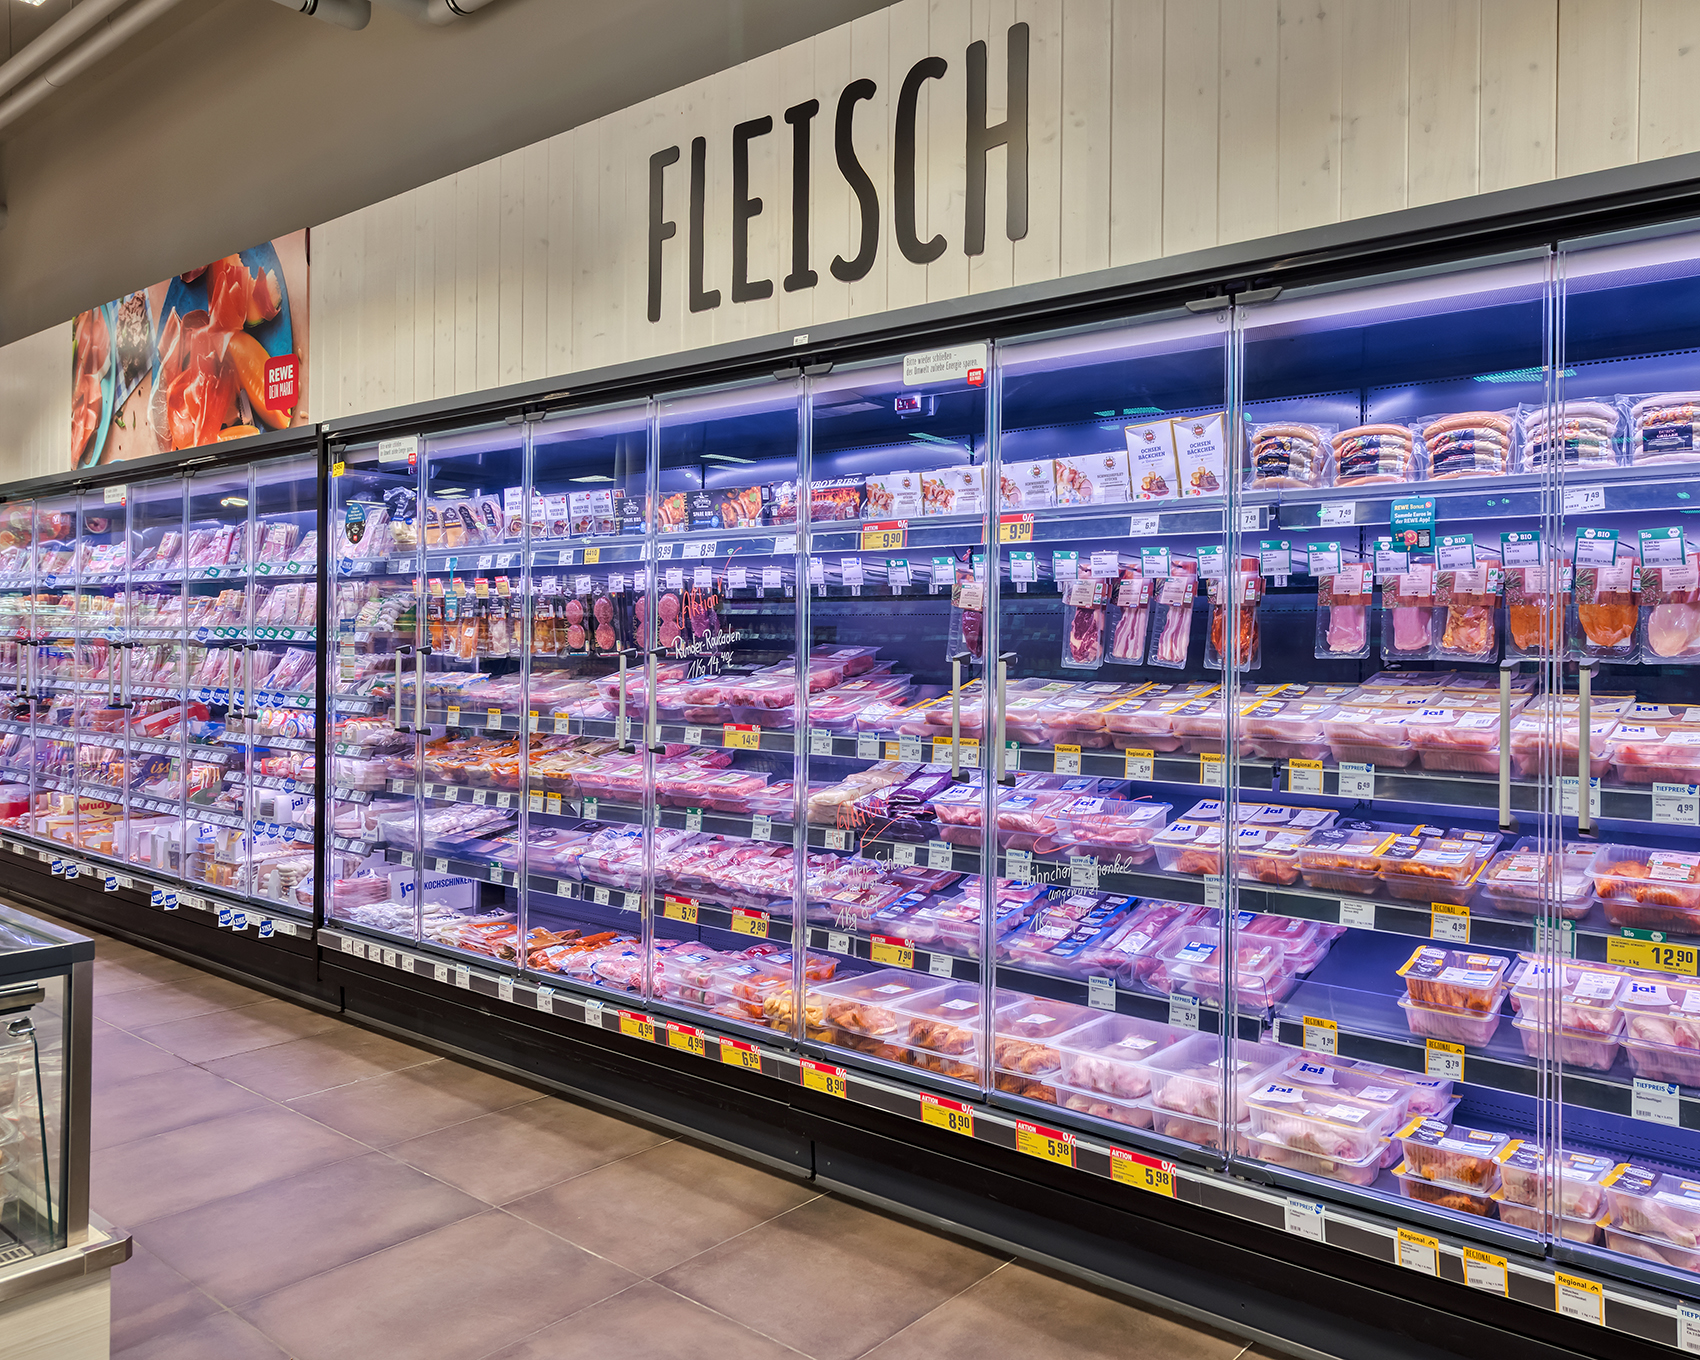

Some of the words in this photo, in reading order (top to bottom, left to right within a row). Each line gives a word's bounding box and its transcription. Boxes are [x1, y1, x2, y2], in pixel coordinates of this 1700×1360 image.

[648, 22, 1029, 322] FLEISCH
[269, 364, 294, 383] REWE
[269, 384, 279, 399] DEIN
[280, 380, 294, 397] MARKT
[1189, 440, 1211, 449] OCHSEN
[1140, 446, 1162, 454] OCHSEN
[835, 477, 859, 487] RIBS
[1056, 745, 1072, 753] Regional
[1127, 750, 1146, 758] Regional
[1202, 754, 1222, 762] Regional
[1291, 760, 1312, 769] Regional
[1341, 763, 1365, 771] TIEFPREIS
[1561, 778, 1579, 786] TIEFPR
[1655, 785, 1686, 794] TIEFPREIS
[79, 801, 112, 812] Wudy
[291, 797, 304, 810] ja!
[1263, 807, 1283, 815] ja!
[199, 825, 213, 837] ja!
[1171, 824, 1191, 832] ja!
[1239, 829, 1260, 837] ja!
[399, 882, 414, 898] ja
[424, 876, 473, 891] KOCHSCHINKEN
[1433, 904, 1456, 914] REGIONAL
[1623, 929, 1635, 938] Bio
[1090, 978, 1107, 986] TIEFPREIS
[1632, 984, 1656, 994] ja!
[1171, 995, 1190, 1004] TIEFPREIS
[667, 1023, 679, 1031] AKTION
[1304, 1017, 1325, 1027] REGIONAL
[720, 1038, 734, 1047] AKTION
[1428, 1040, 1451, 1051] REGIONAL
[801, 1060, 816, 1070] AKTION
[1300, 1063, 1325, 1074] ja!
[1267, 1084, 1293, 1094] ja!
[1636, 1081, 1666, 1092] TIEFPREIS
[921, 1095, 939, 1105] AKTION
[1017, 1122, 1037, 1134] AKTION
[1111, 1149, 1132, 1161] AKTION
[1289, 1200, 1313, 1212] TIEFPREIS
[1400, 1231, 1426, 1244] Regional
[1465, 1249, 1492, 1264] REGIONAL
[1558, 1275, 1587, 1289] Regional
